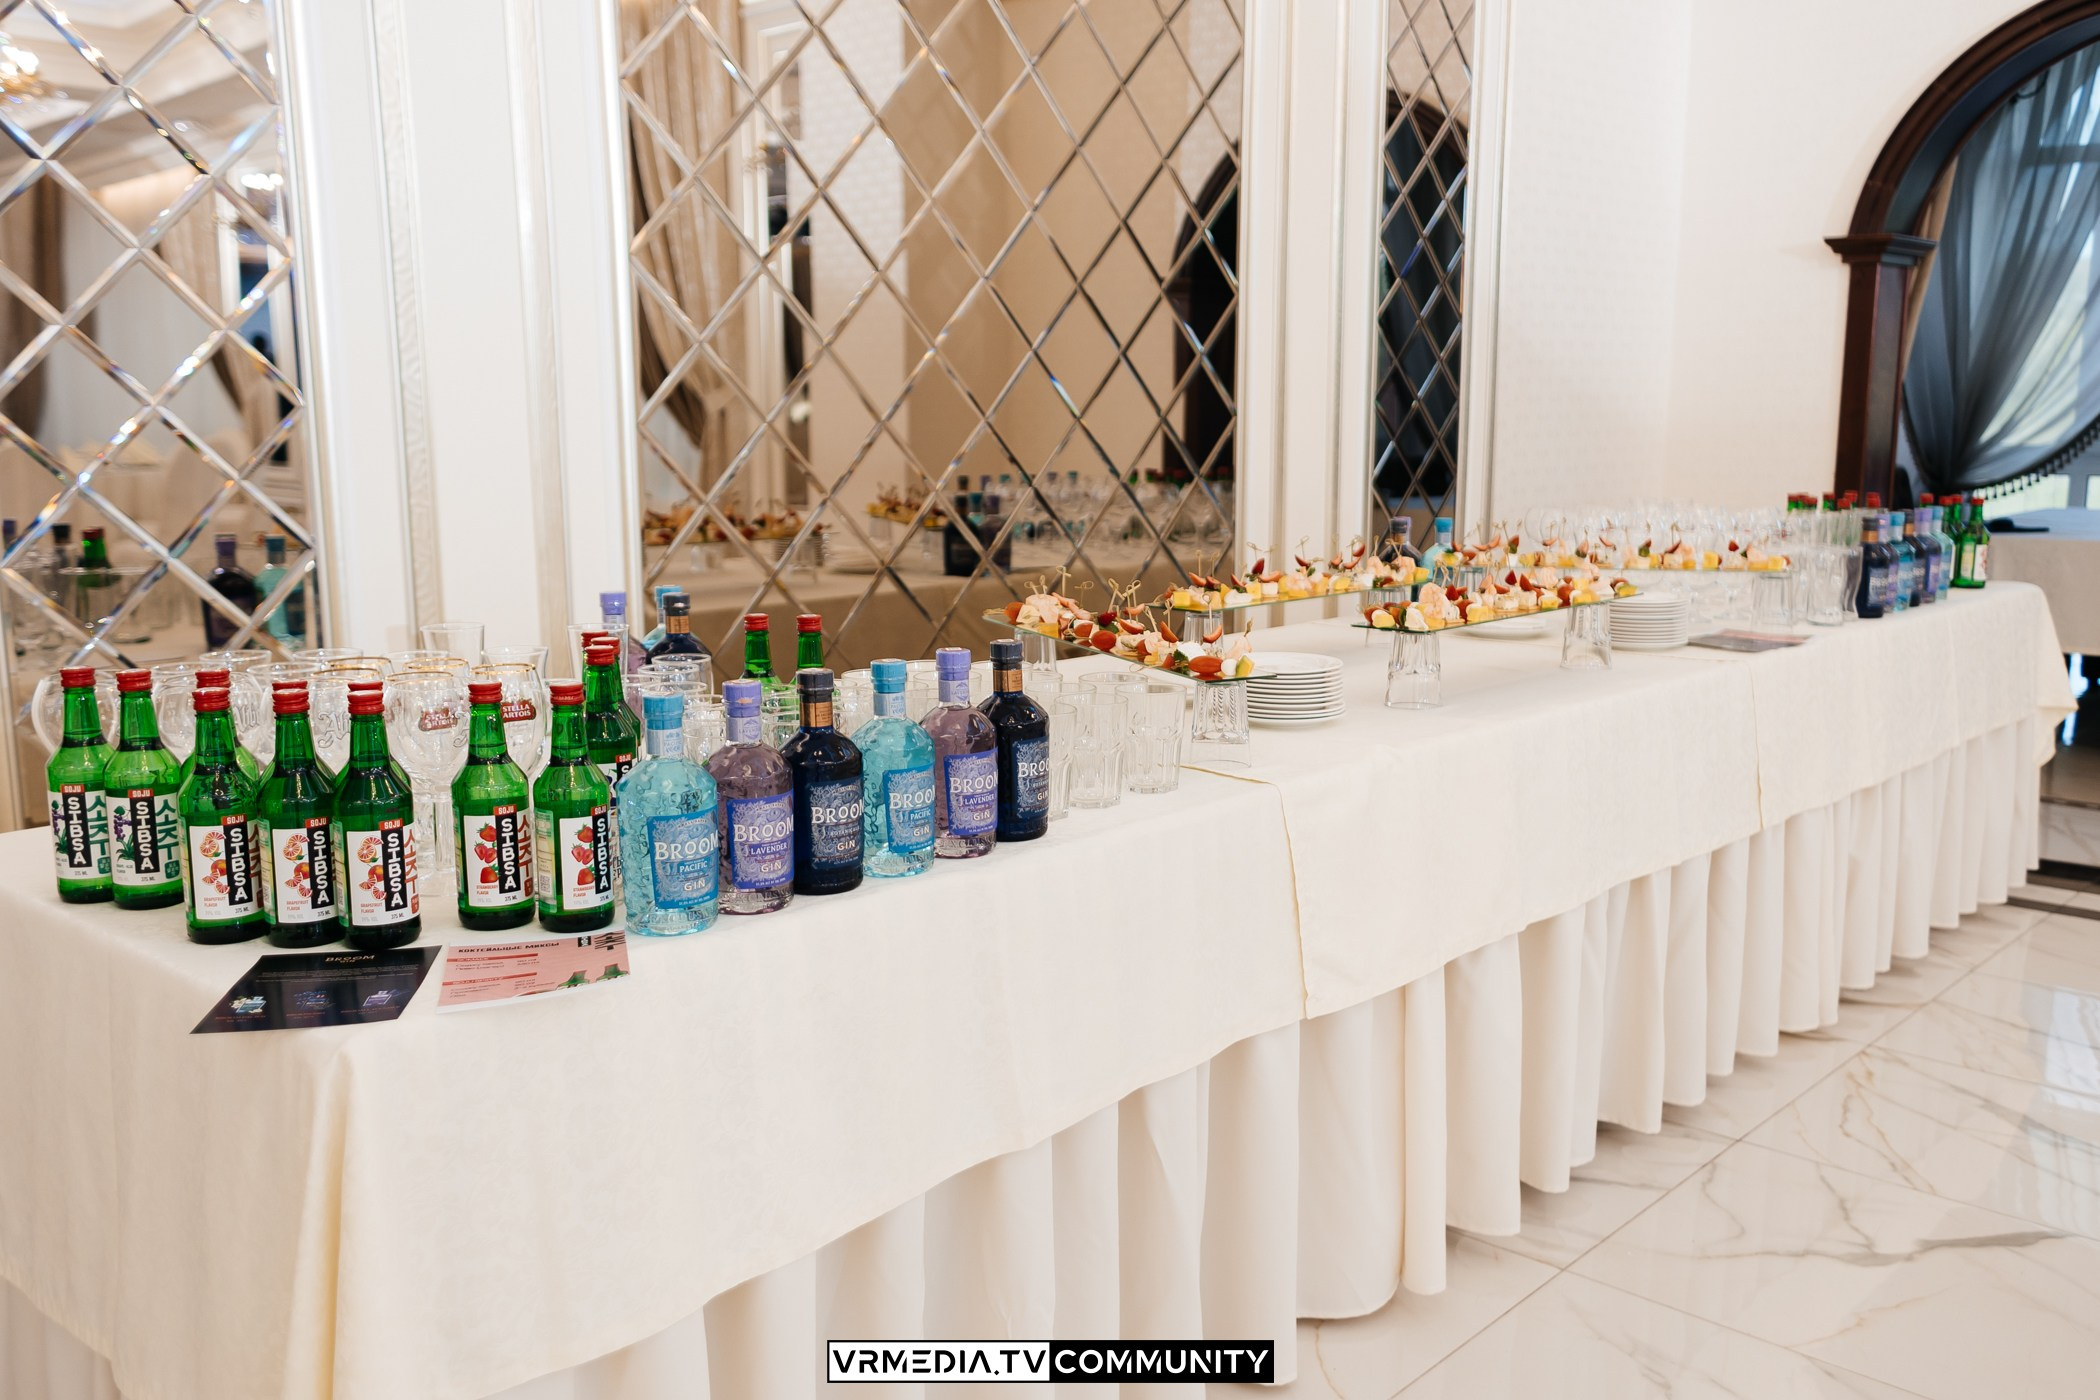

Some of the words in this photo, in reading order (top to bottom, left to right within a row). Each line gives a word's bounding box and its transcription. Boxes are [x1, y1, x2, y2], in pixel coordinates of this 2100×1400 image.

[502, 704, 530, 712] STELLA
[502, 710, 531, 718] ARTOIS
[619, 754, 631, 762] SOJU
[132, 790, 150, 798] SOJU
[964, 794, 994, 804] LAVENDER
[498, 806, 514, 814] SOJU
[594, 806, 606, 815] SOJU
[910, 809, 930, 820] PACIFIC
[226, 815, 244, 824] SOJU
[974, 812, 990, 820] GIN
[310, 818, 326, 826] SOJU
[384, 822, 400, 830] SOJU
[68, 797, 87, 864] SIBSA
[156, 799, 180, 860] 소주
[734, 814, 794, 842] BROOM
[914, 826, 930, 836] GIN
[136, 802, 154, 870] SIBSA
[654, 830, 718, 860] BROOM
[750, 842, 788, 854] LAVENDER
[837, 840, 856, 850] GIN
[501, 818, 516, 890] SIBSA
[597, 818, 608, 890] SIBSA
[230, 828, 248, 902] SIBSA
[313, 830, 330, 904] SIBSA
[387, 833, 404, 907] SIBSA
[680, 861, 708, 872] PACIFIC
[762, 862, 782, 872] GIN
[684, 880, 706, 891] GIN
[325, 954, 375, 962] BROOM
